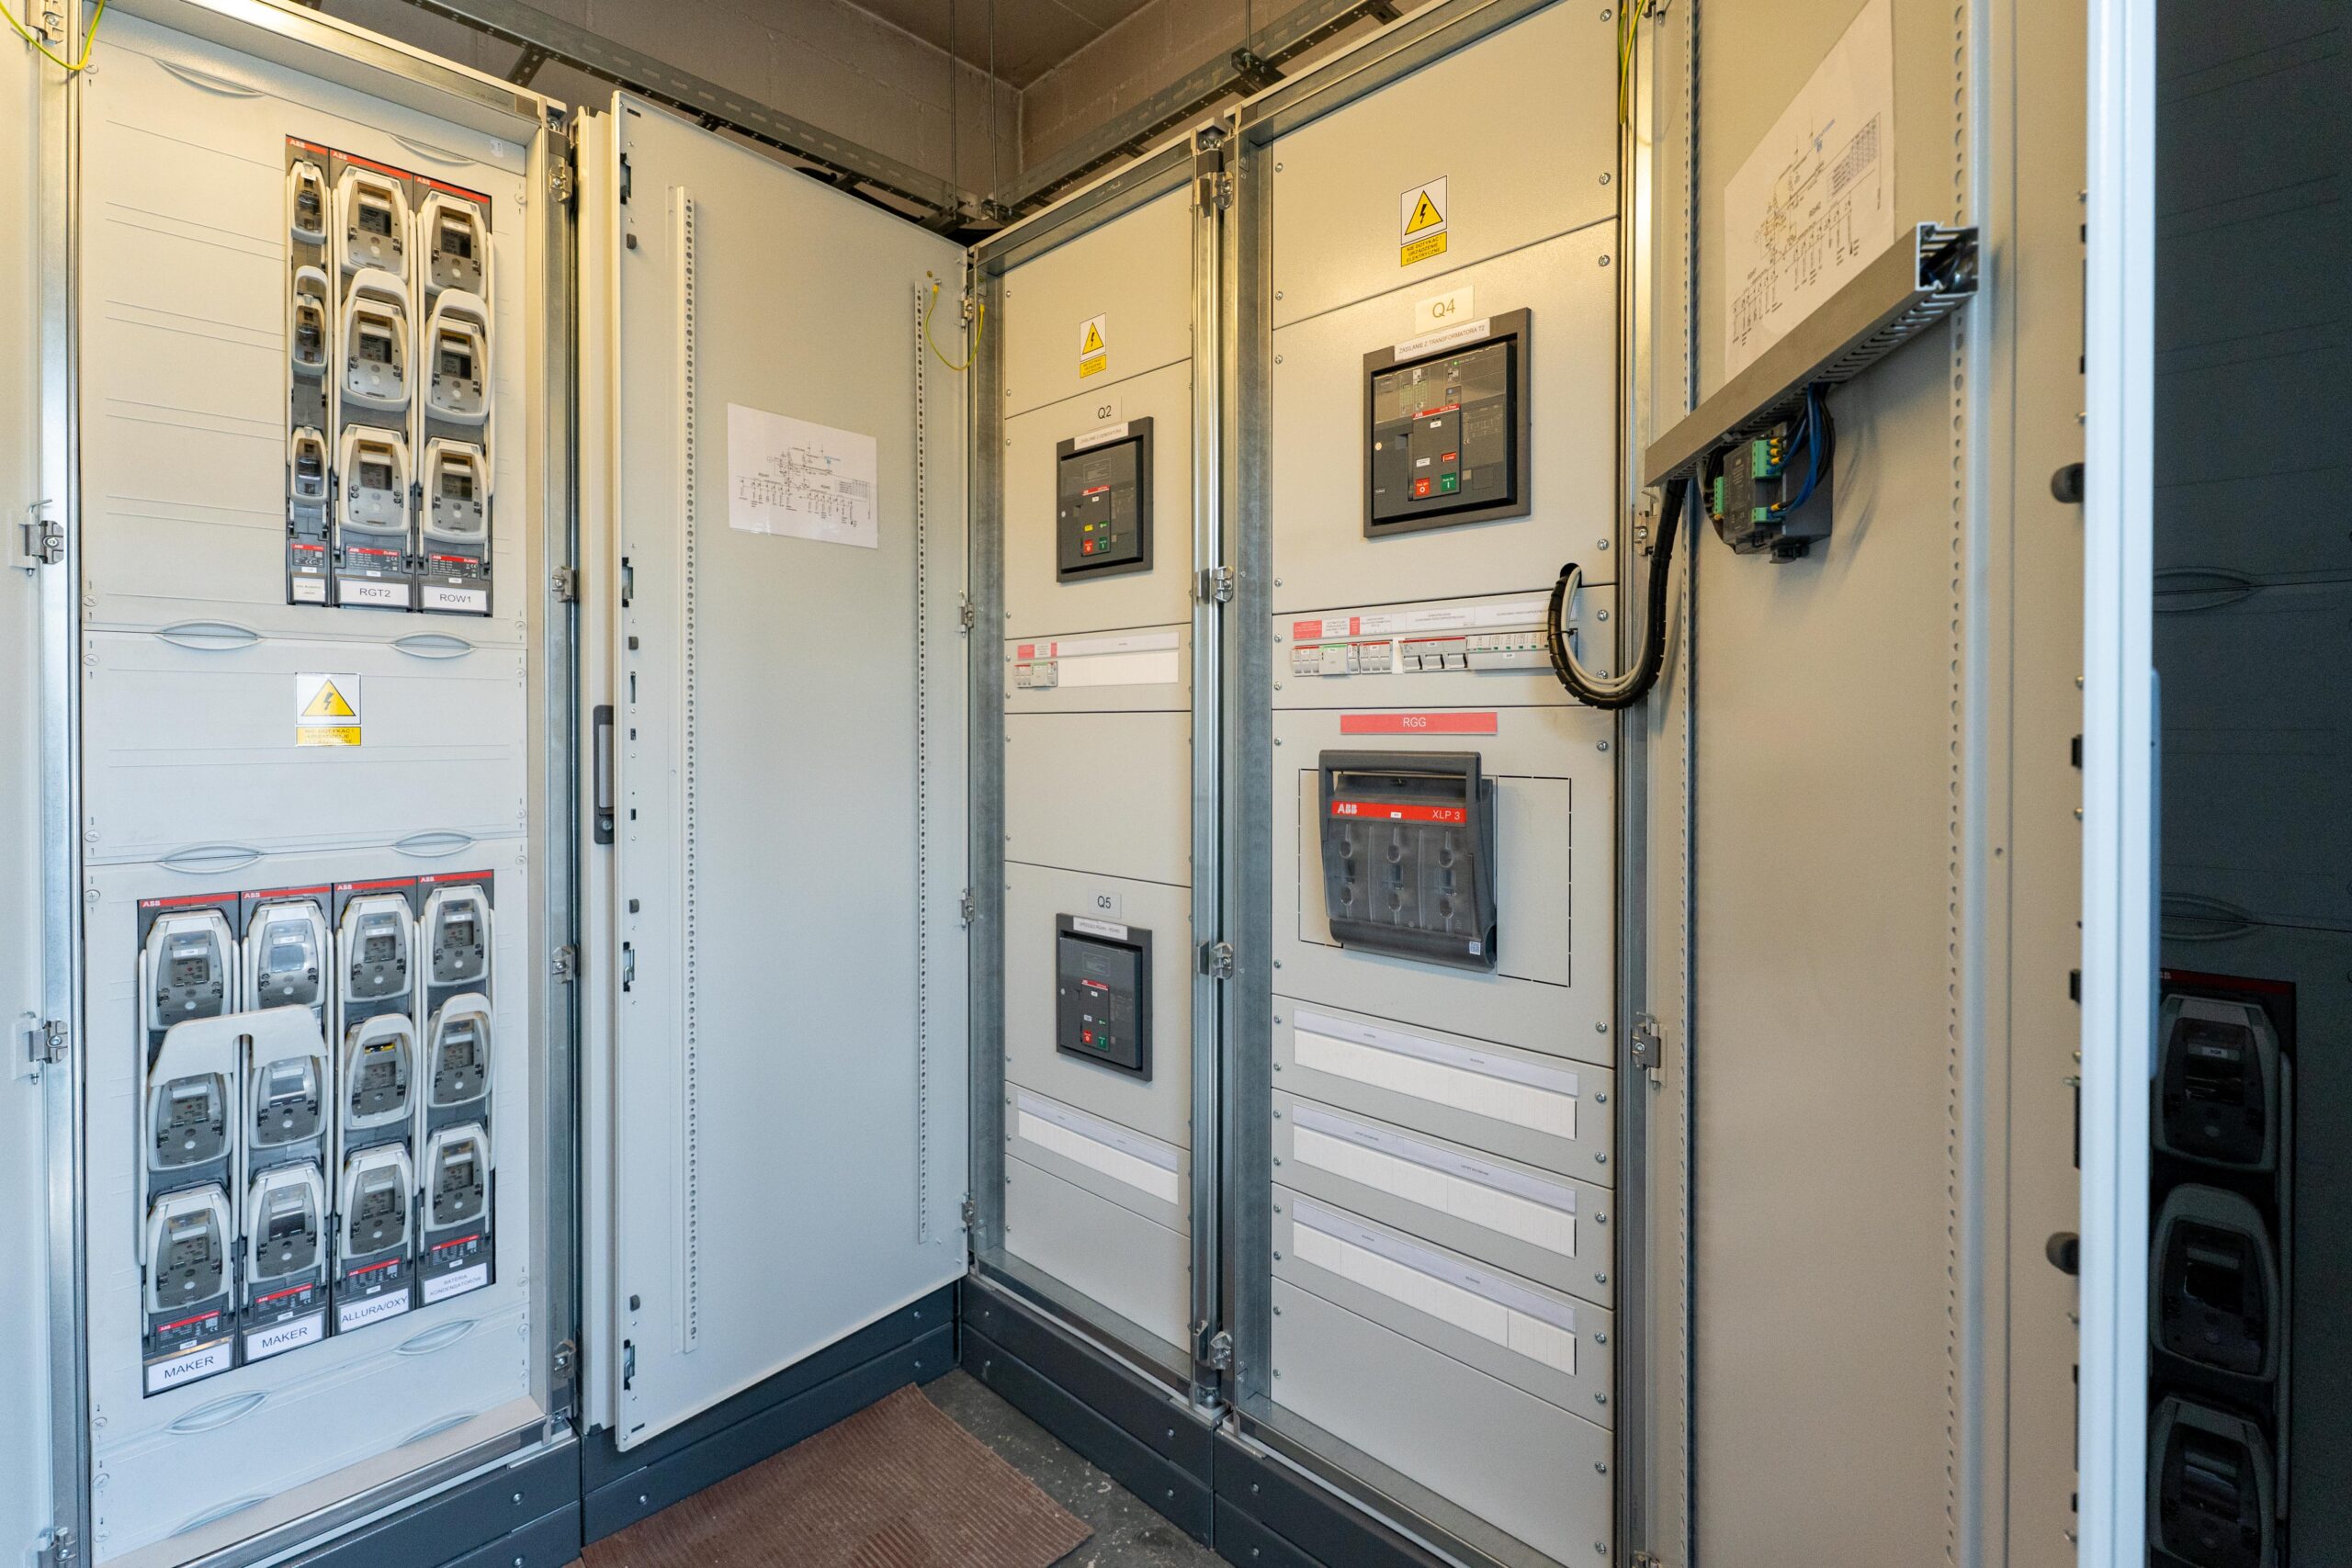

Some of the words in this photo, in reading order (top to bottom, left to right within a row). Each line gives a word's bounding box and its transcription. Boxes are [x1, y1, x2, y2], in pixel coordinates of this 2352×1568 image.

[289, 139, 306, 149] ABB
[333, 152, 348, 161] ABB
[416, 177, 431, 186] ABB
[1432, 298, 1455, 318] Q4
[1098, 405, 1112, 419] Q2
[359, 588, 390, 597] RGT2
[439, 593, 471, 603] ROW1
[1402, 717, 1427, 728] RGG
[1337, 803, 1358, 815] ABB
[1432, 809, 1452, 819] XLP
[1454, 811, 1461, 820] 3
[1097, 896, 1112, 909] Q5
[443, 1274, 469, 1285] BATERIA
[341, 1295, 408, 1324] ALLURA/OXY
[262, 1326, 308, 1349] MAKER
[164, 1355, 215, 1380] MAKER
